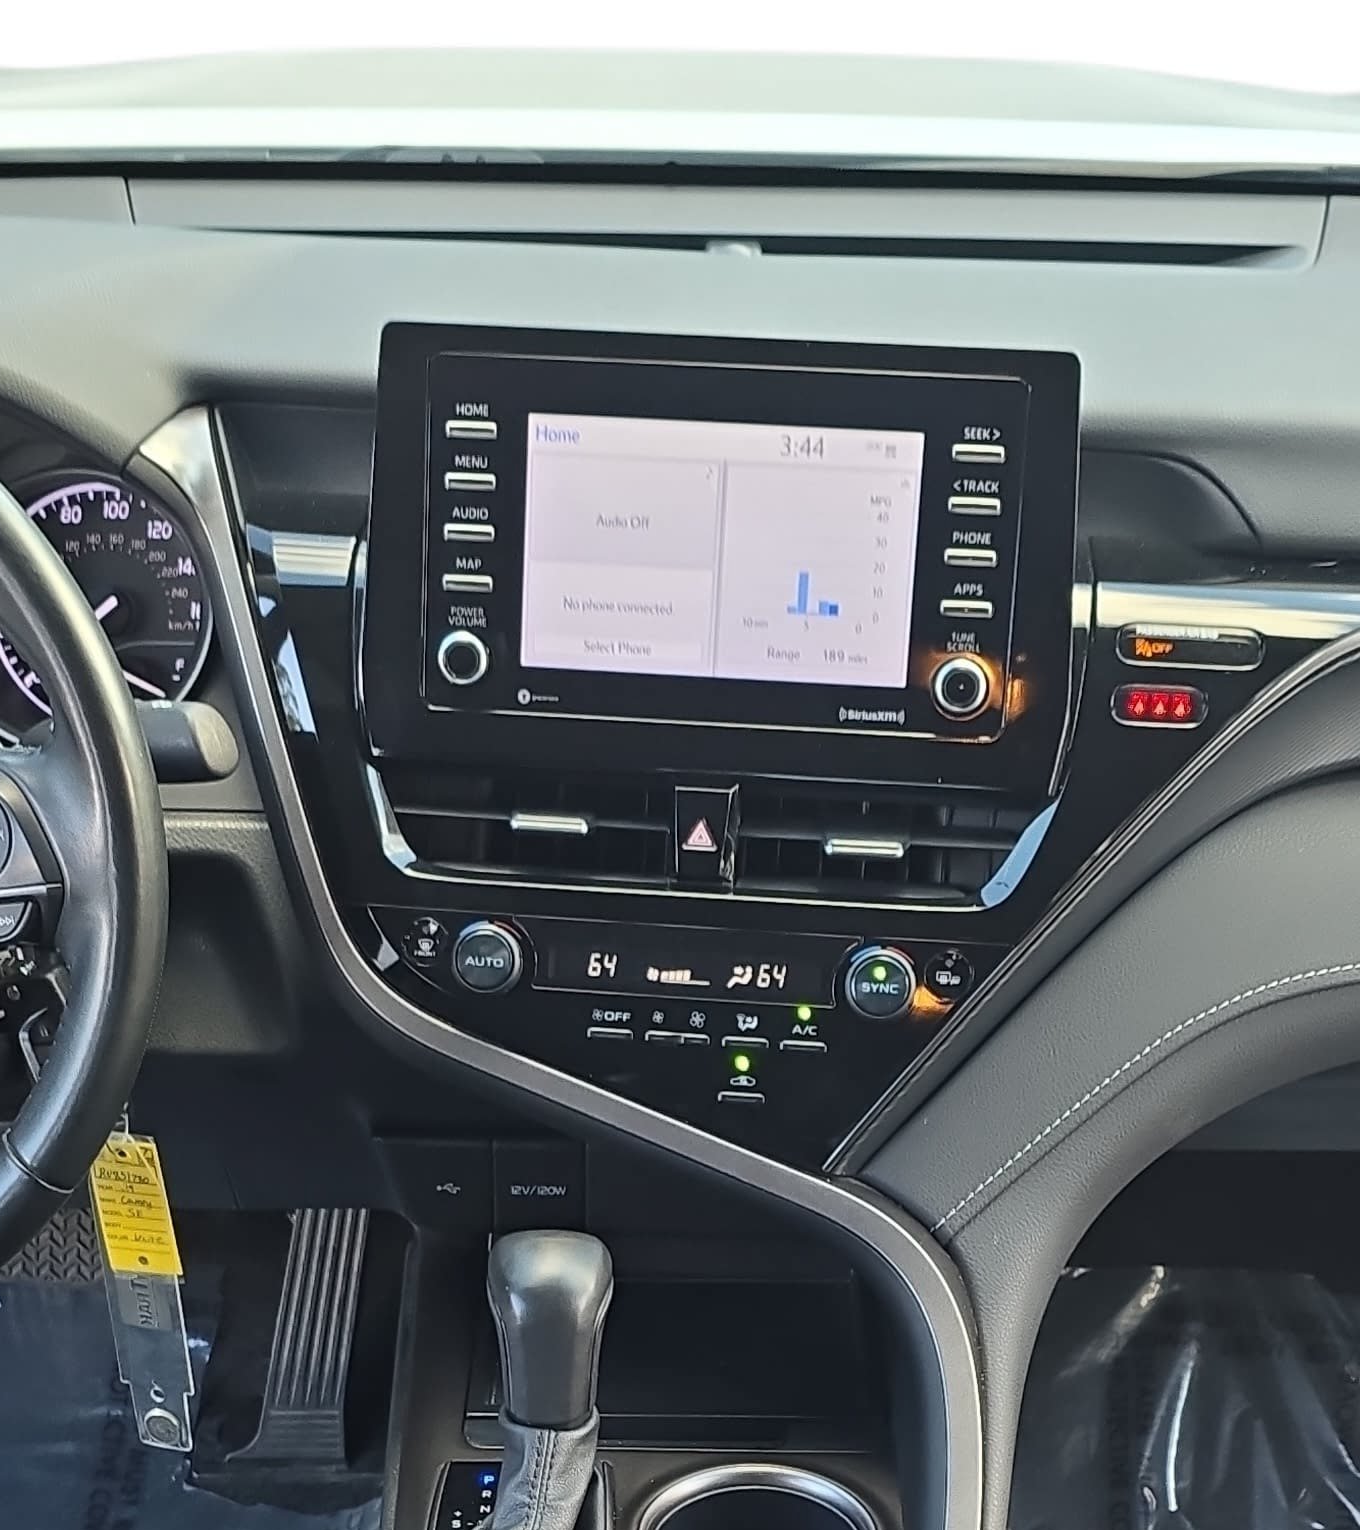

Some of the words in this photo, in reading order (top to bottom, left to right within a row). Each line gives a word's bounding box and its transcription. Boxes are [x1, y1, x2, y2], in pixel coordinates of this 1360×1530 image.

[455, 403, 489, 417] HOME
[535, 424, 580, 444] Home
[963, 426, 990, 441] SEEK
[780, 434, 825, 460] 3:44
[454, 455, 489, 469] MENU
[963, 479, 999, 494] TRACK
[60, 504, 82, 524] 80
[103, 500, 130, 520] 100
[452, 506, 489, 521] AUDIO
[595, 513, 628, 530] Audio
[630, 514, 650, 531] Off
[147, 520, 173, 541] 120
[952, 532, 992, 546] PHONE
[455, 557, 482, 571] MAP
[953, 583, 983, 597] APPS
[450, 606, 485, 619] POWER
[563, 596, 581, 612] No
[582, 598, 615, 615] phone
[616, 600, 673, 617] connected
[448, 615, 488, 629] VOLUME
[951, 631, 976, 644] TUNE
[583, 639, 617, 655] Select
[618, 640, 652, 657] Phone
[767, 645, 801, 662] Range
[823, 648, 845, 663] 189
[946, 640, 981, 654] SCROLL
[464, 955, 505, 969] AUTO
[587, 952, 618, 979] 64
[756, 962, 789, 990] 64
[861, 981, 901, 995] SYNC
[605, 1010, 632, 1024] OFF
[792, 1023, 818, 1038] A/C
[510, 1184, 567, 1196] 12V/120W
[483, 1475, 495, 1485] P
[481, 1489, 492, 1499] R
[479, 1504, 491, 1514] N
[451, 1519, 461, 1529] S
